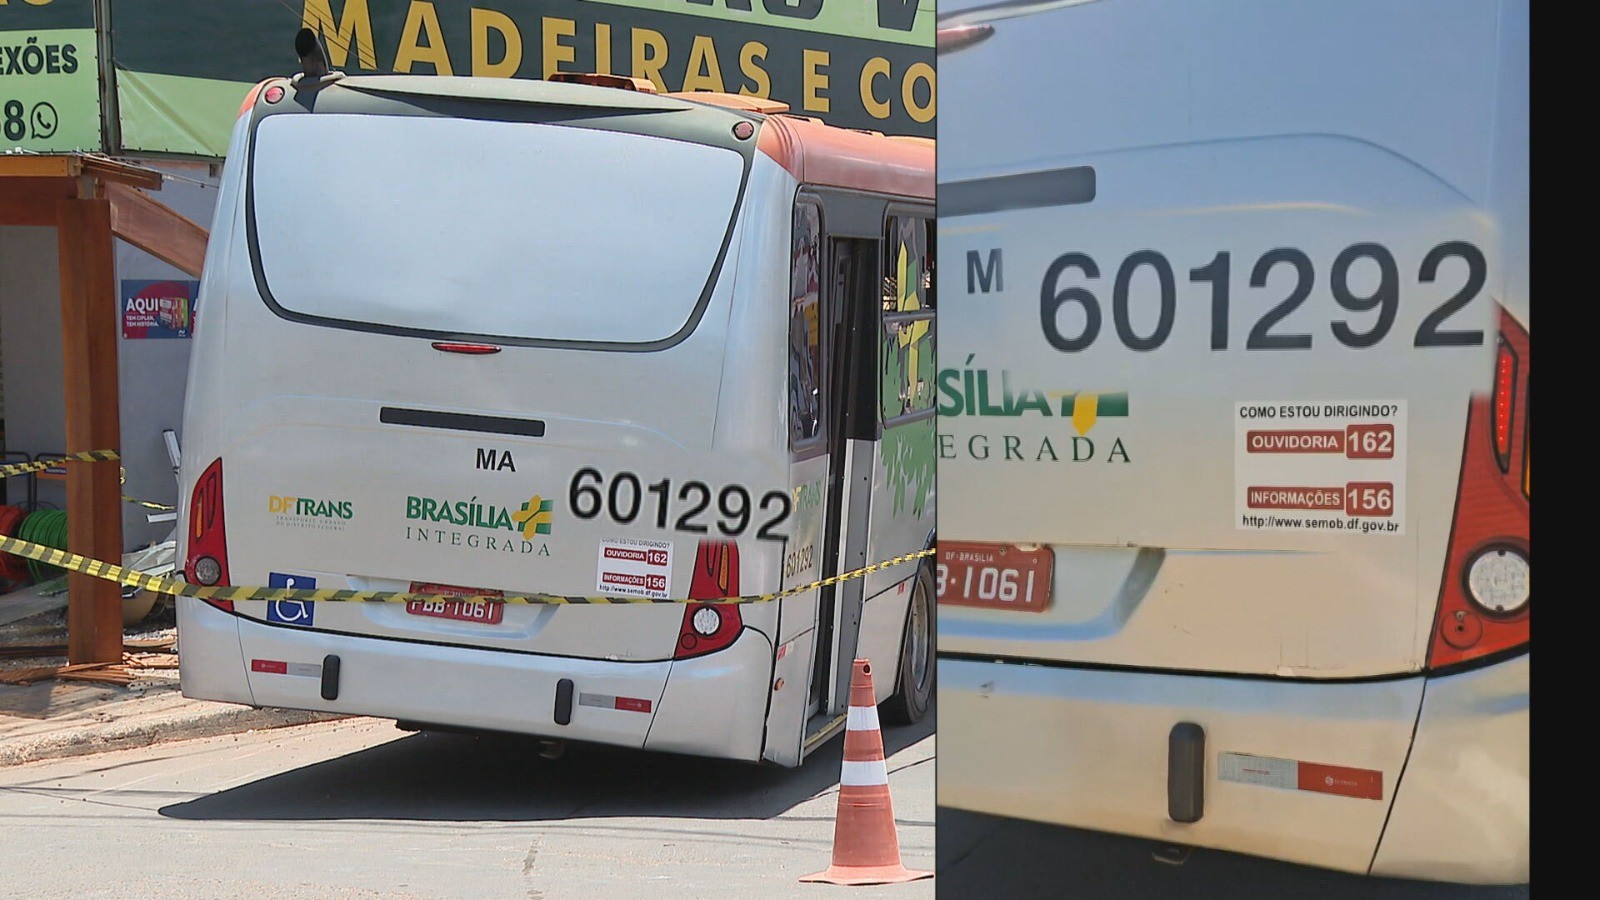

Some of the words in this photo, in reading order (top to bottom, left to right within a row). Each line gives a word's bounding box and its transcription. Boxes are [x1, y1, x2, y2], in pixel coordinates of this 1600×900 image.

[0, 36, 78, 75] XÕES
[302, 0, 771, 100] MADEIRAS
[803, 49, 830, 112] E
[859, 57, 936, 123] CO
[966, 248, 1004, 294] M
[126, 298, 158, 314] AQUI
[1040, 240, 1487, 352] 601292
[1240, 406, 1276, 418] COMO
[1279, 406, 1320, 418] ESTOU
[1324, 405, 1398, 418] DIRIGINDO?
[938, 434, 1131, 463] EGRADA
[1252, 436, 1338, 448] OUVIDORIA
[1348, 431, 1392, 453] 162
[476, 448, 516, 472] MA
[269, 495, 353, 519] DFTRANS
[569, 467, 792, 541] 601292
[1251, 490, 1340, 507] INFORMAÇÕES
[1348, 489, 1392, 510] 156
[406, 496, 513, 532] BRASÍLIA
[1242, 514, 1399, 533] http://www.semob.df.gov.br
[406, 527, 550, 556] INTEGRADA
[606, 549, 645, 559] OUVIDORIA
[648, 553, 667, 563] 162
[786, 544, 813, 578] 601292
[603, 574, 644, 585] INFORMAÇÕES
[646, 577, 665, 588] 156
